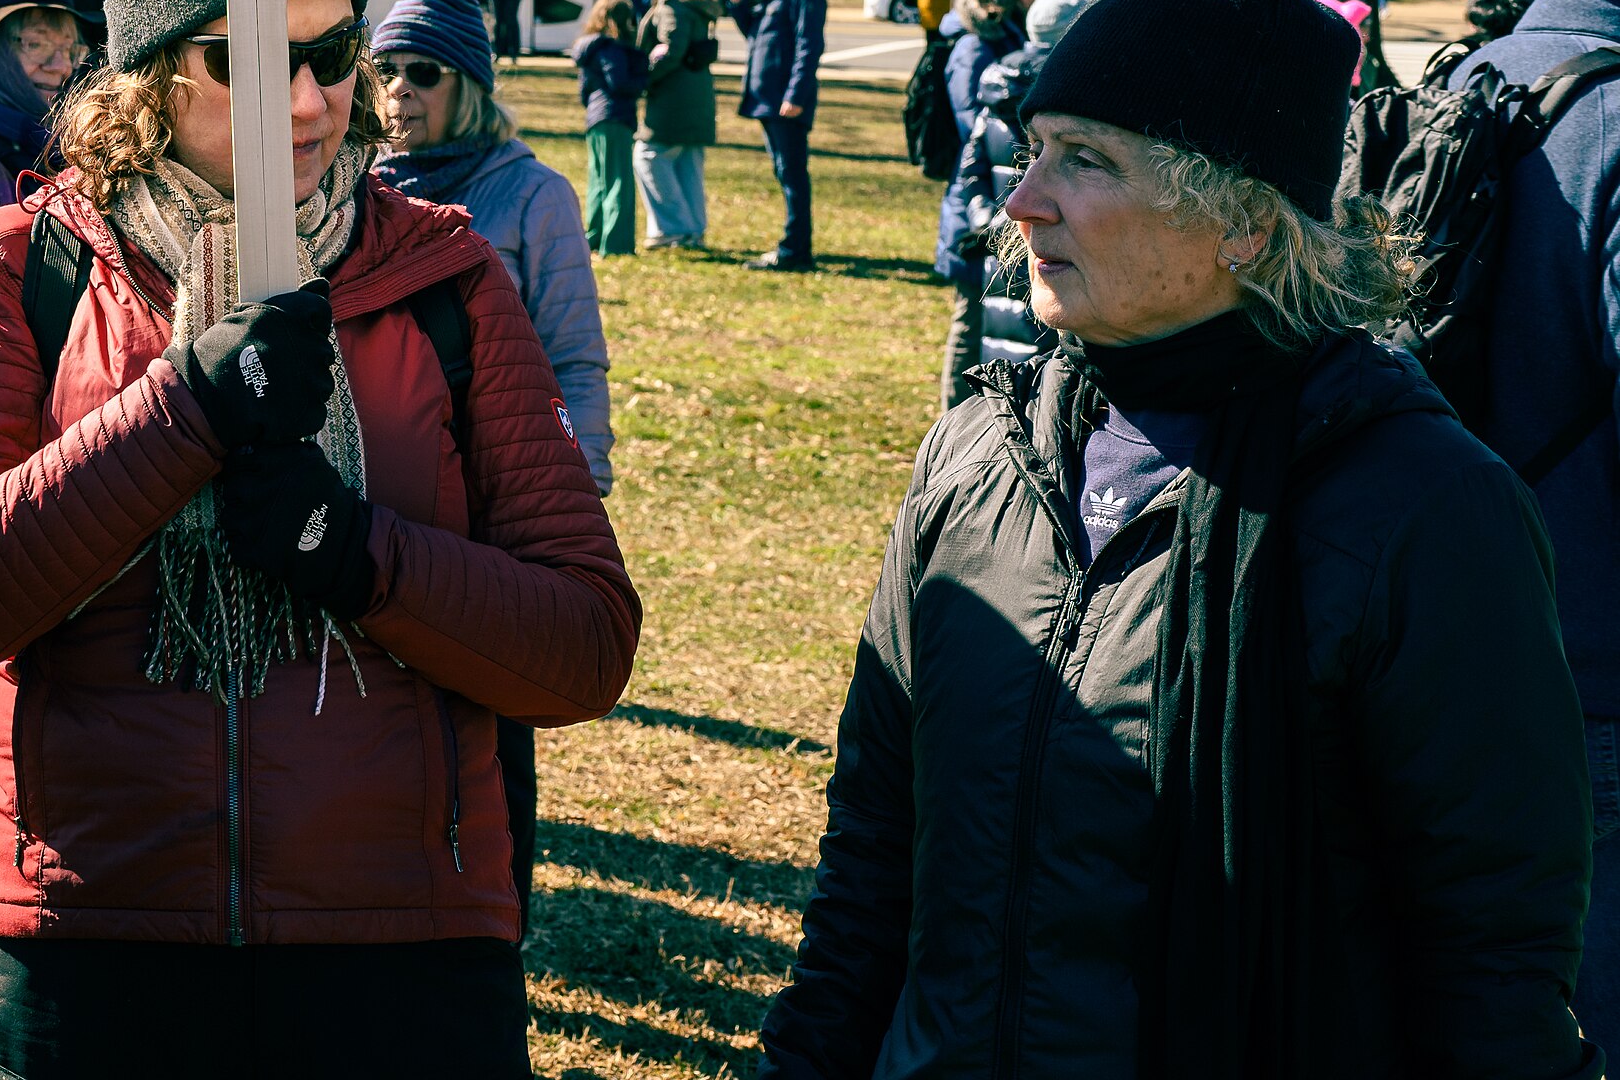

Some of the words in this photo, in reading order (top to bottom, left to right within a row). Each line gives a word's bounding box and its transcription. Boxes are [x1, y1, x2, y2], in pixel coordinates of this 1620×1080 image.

[240, 366, 254, 386] THE
[247, 363, 265, 398] NORTH
[254, 361, 270, 386] FACE
[307, 503, 329, 538] NORTH
[1083, 514, 1118, 531] adidas
